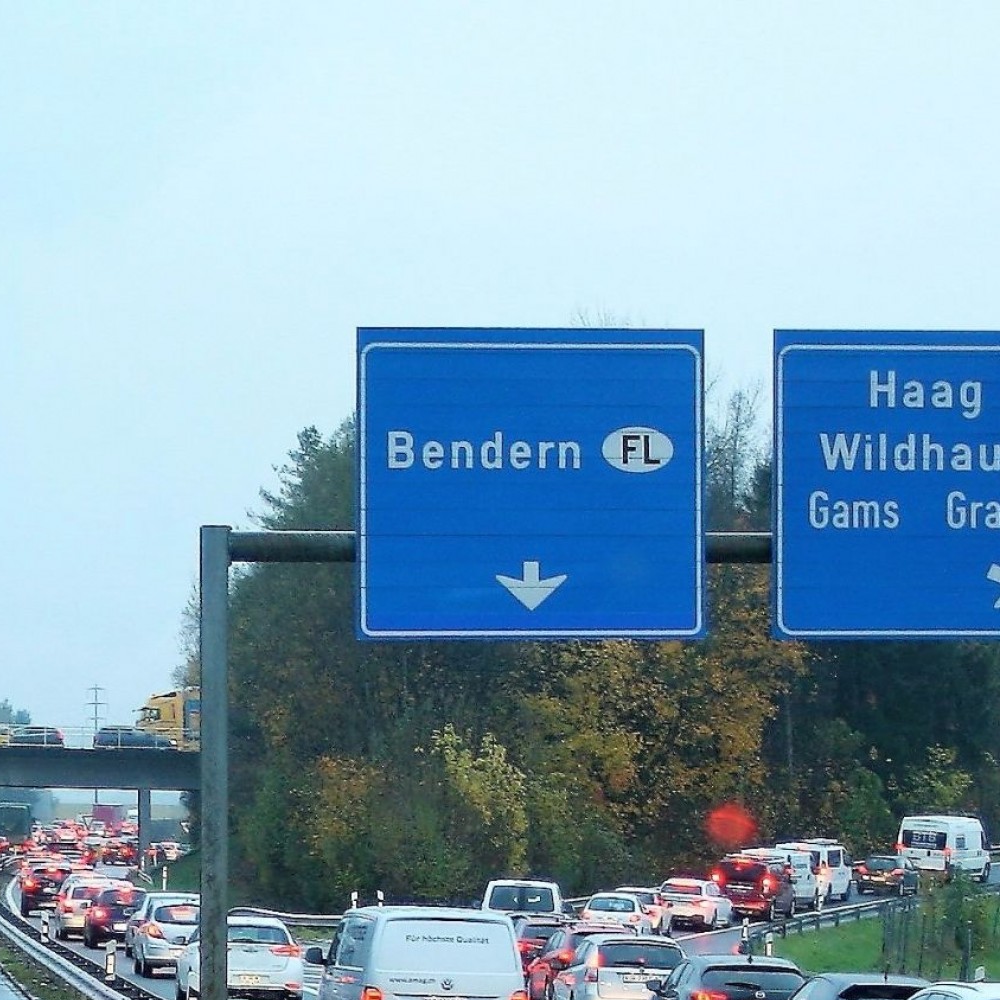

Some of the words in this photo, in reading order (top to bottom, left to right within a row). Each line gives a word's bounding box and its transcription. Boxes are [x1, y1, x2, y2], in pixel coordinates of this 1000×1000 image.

[870, 370, 982, 419] Haag
[387, 431, 581, 469] Bendern
[622, 434, 661, 465] FL
[809, 490, 899, 529] Gams
